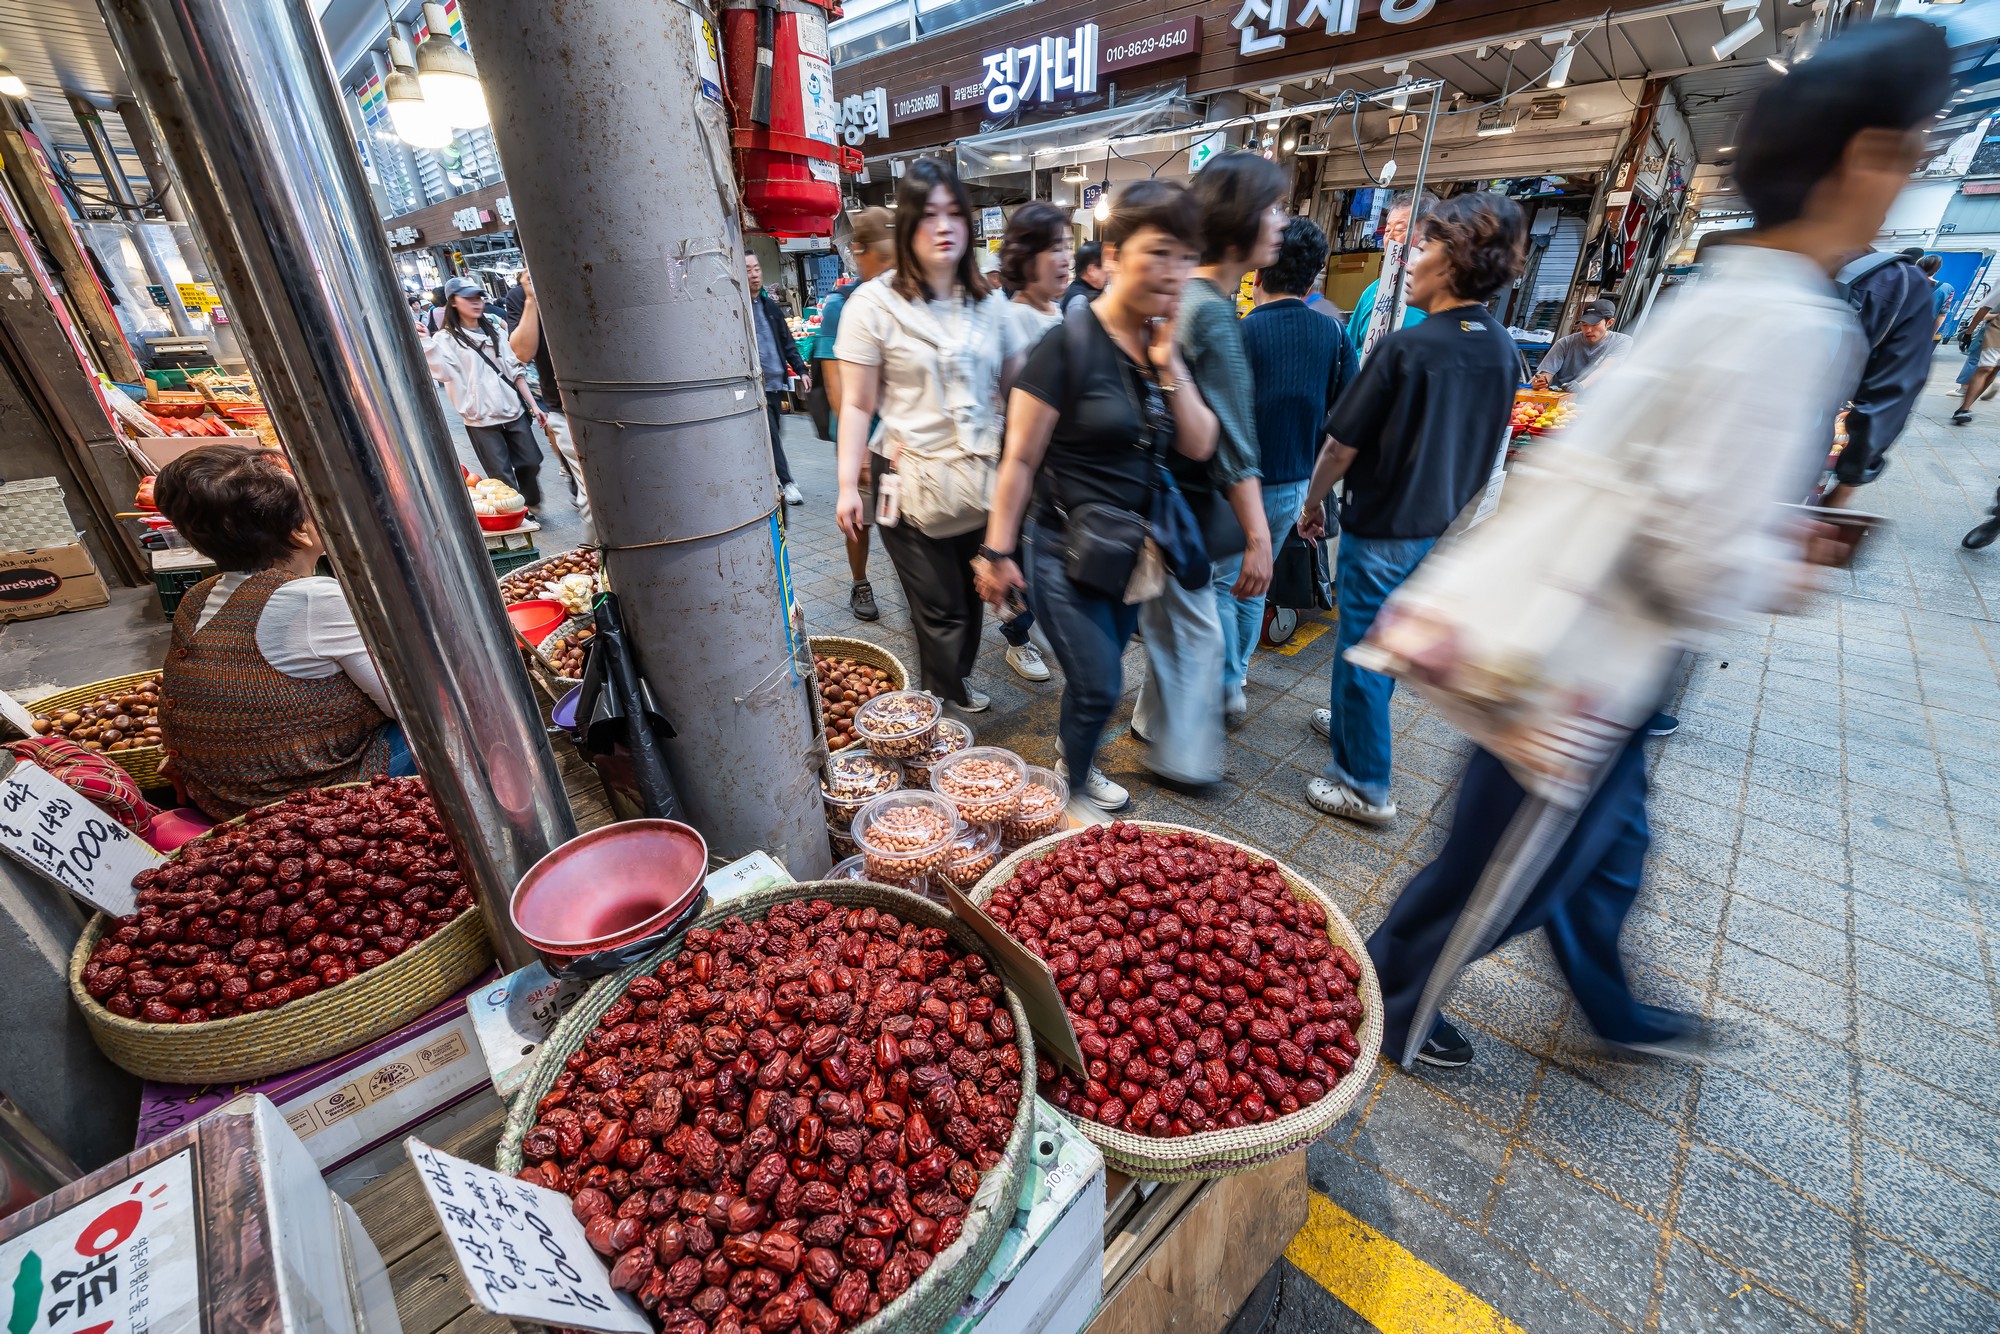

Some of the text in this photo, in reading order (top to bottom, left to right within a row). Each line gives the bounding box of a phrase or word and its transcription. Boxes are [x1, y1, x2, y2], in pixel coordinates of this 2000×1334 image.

[982, 22, 1099, 114] 정가네
[1106, 29, 1187, 63] 010-8629-4540
[834, 86, 890, 146] 상회
[48, 1200, 143, 1328] 영동
